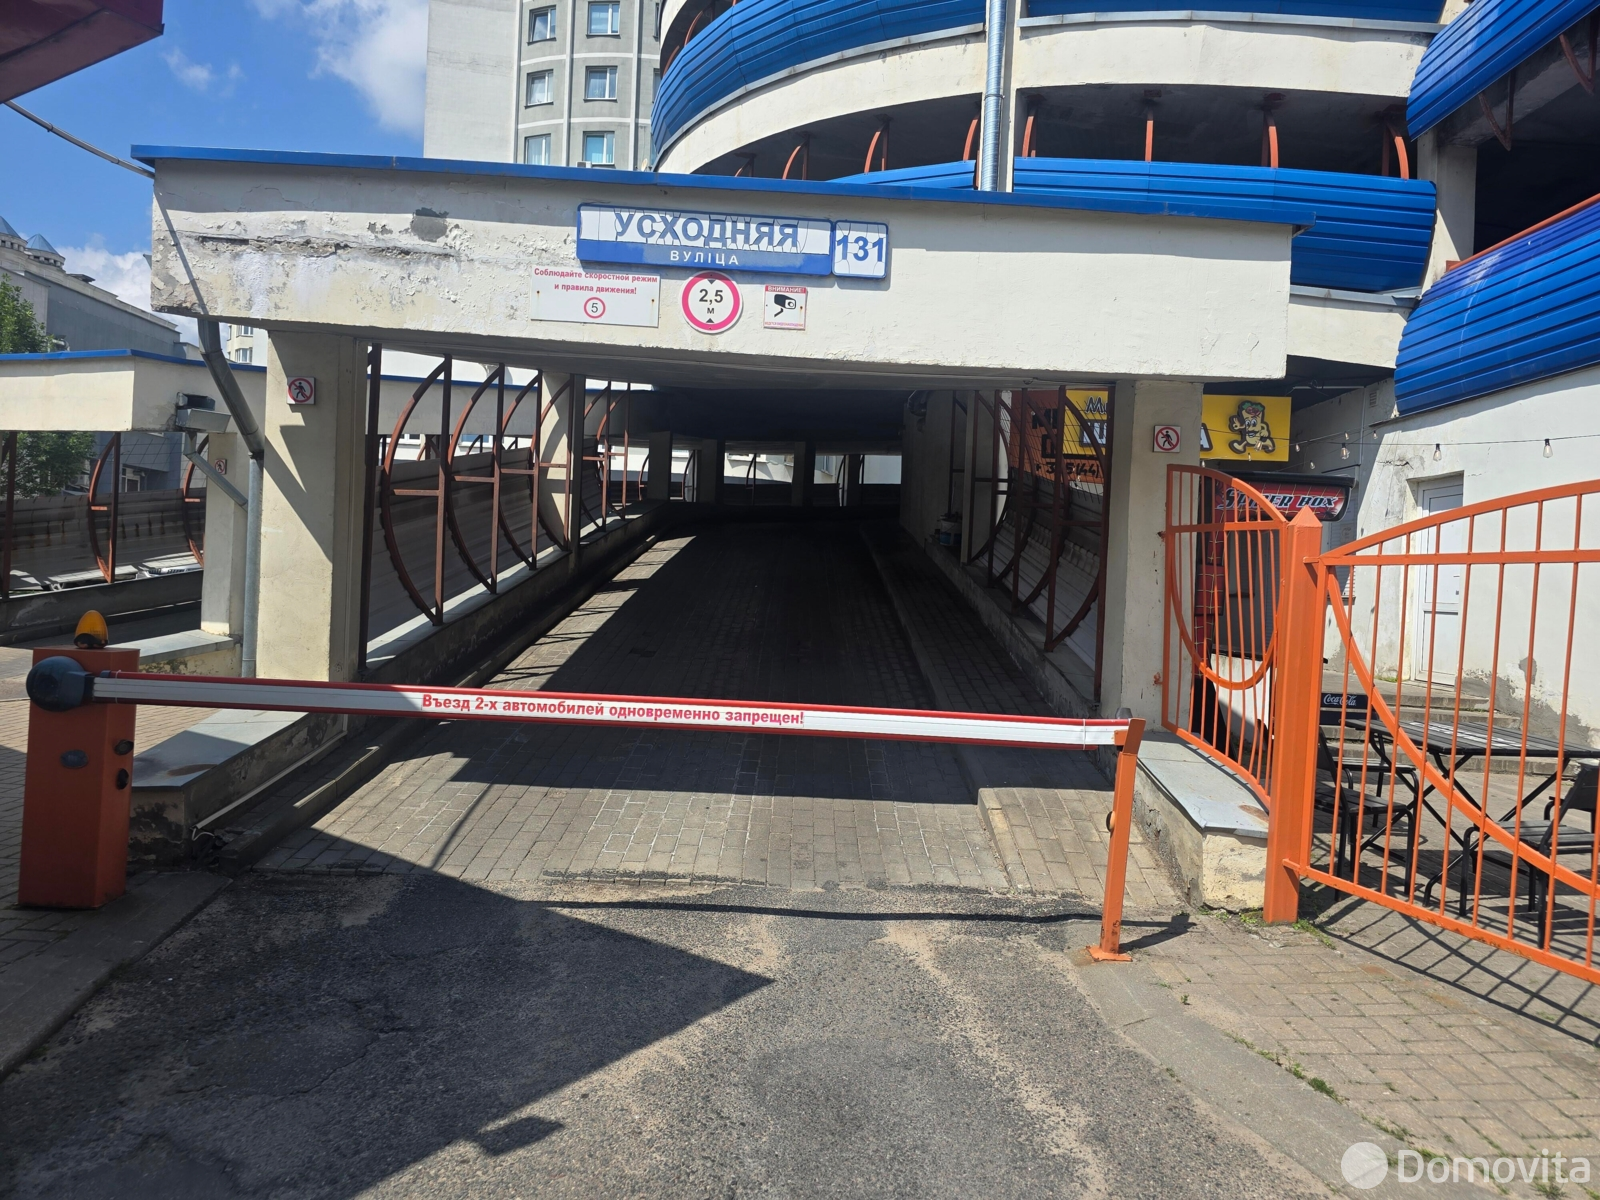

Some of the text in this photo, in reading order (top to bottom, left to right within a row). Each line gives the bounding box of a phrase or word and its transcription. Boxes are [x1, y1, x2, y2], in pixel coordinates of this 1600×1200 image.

[614, 212, 799, 248] УСХОДНЯЯ
[836, 235, 885, 263] 131
[670, 250, 739, 266] ВУЛІЦА
[534, 268, 658, 283] Соблюдайте скоростной режим
[561, 284, 594, 292] правила
[595, 286, 637, 295] движения!
[699, 288, 724, 305] 2,5
[591, 302, 599, 313] 5
[1297, 495, 1338, 508] BOX
[422, 694, 805, 725] Въезд 2-х автомобилей одновременно запрещен!
